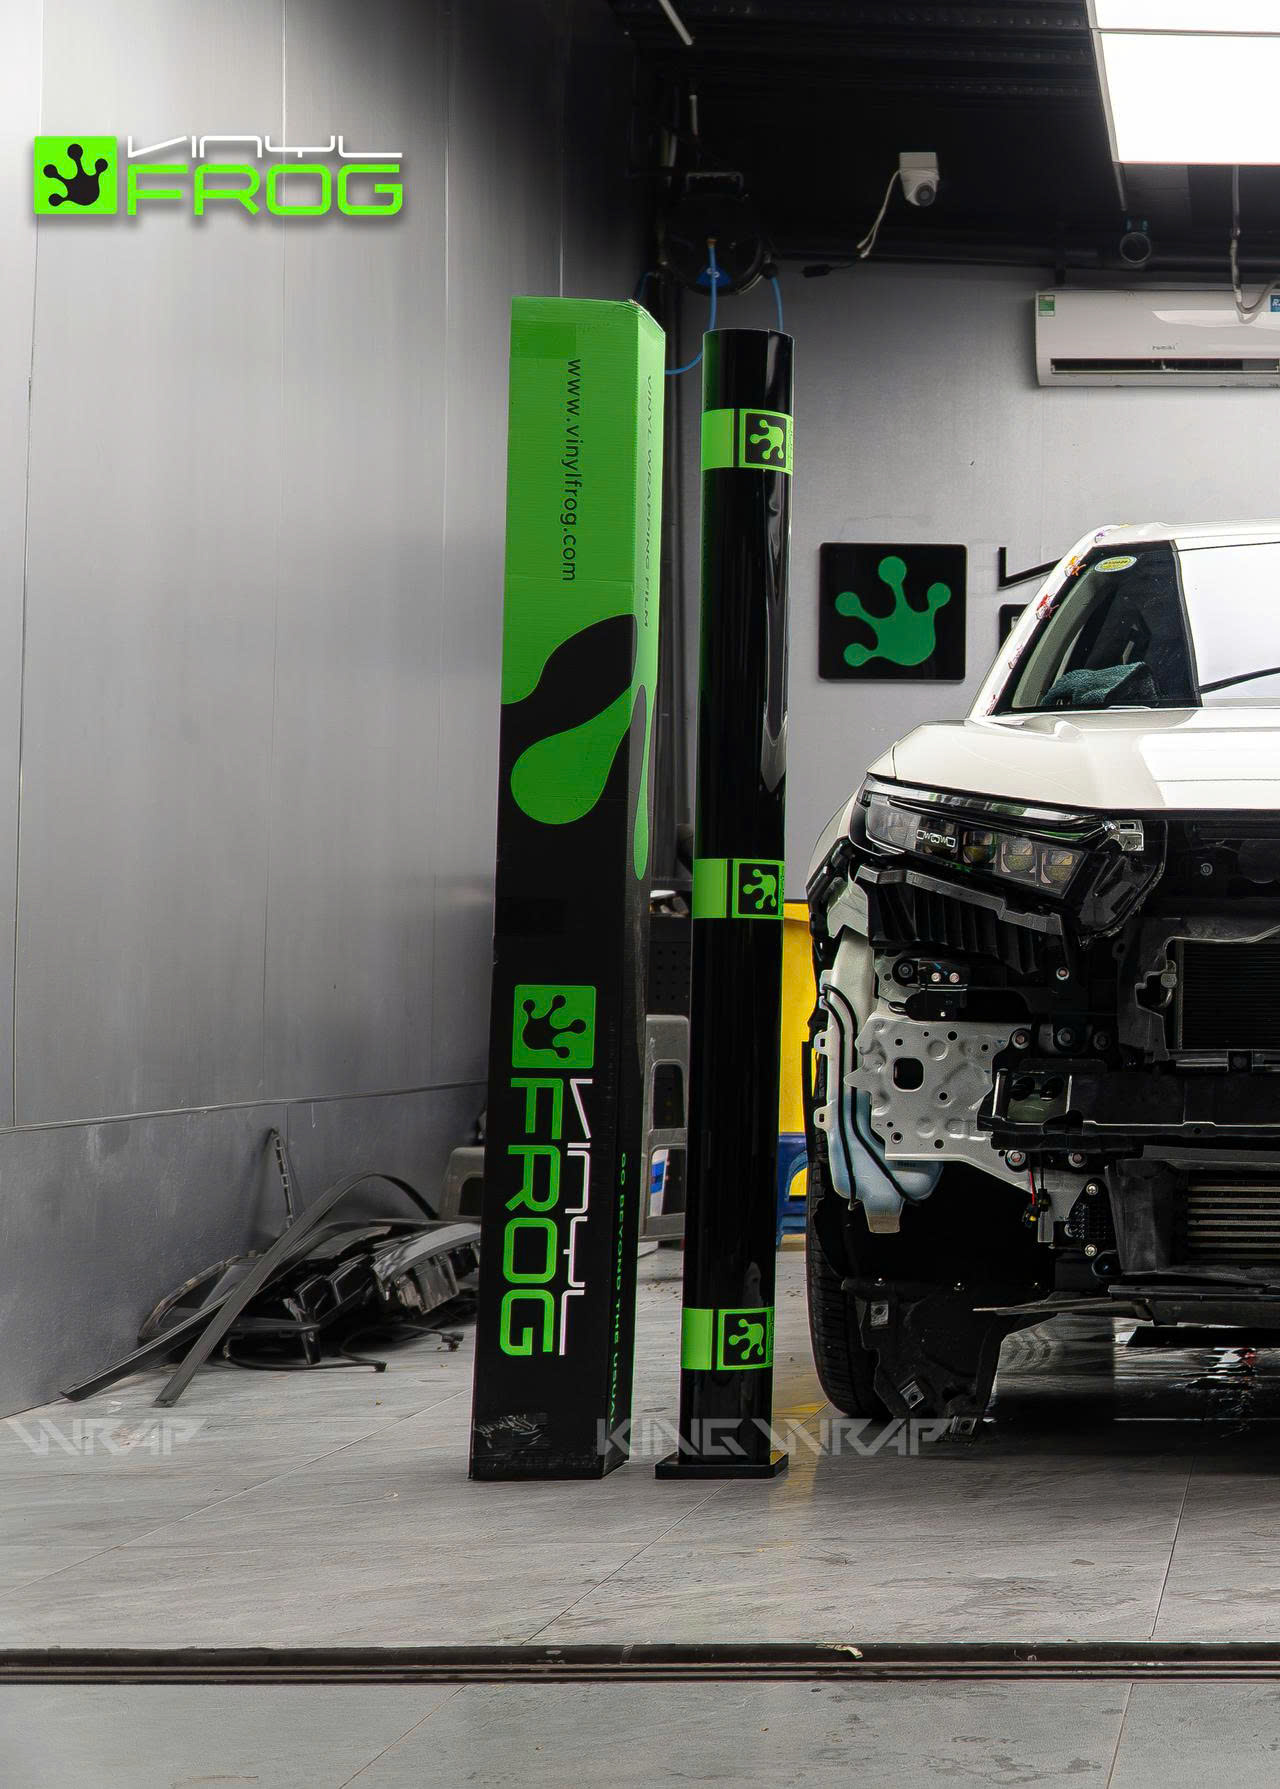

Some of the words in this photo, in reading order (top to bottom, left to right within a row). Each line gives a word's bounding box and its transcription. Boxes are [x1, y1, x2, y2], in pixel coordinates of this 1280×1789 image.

[559, 358, 583, 582] www.vinylfrog.com
[499, 1077, 564, 1357] FROG
[559, 1077, 595, 1356] VINYL
[613, 1298, 621, 1344] THE
[616, 1194, 625, 1290] BEYOND
